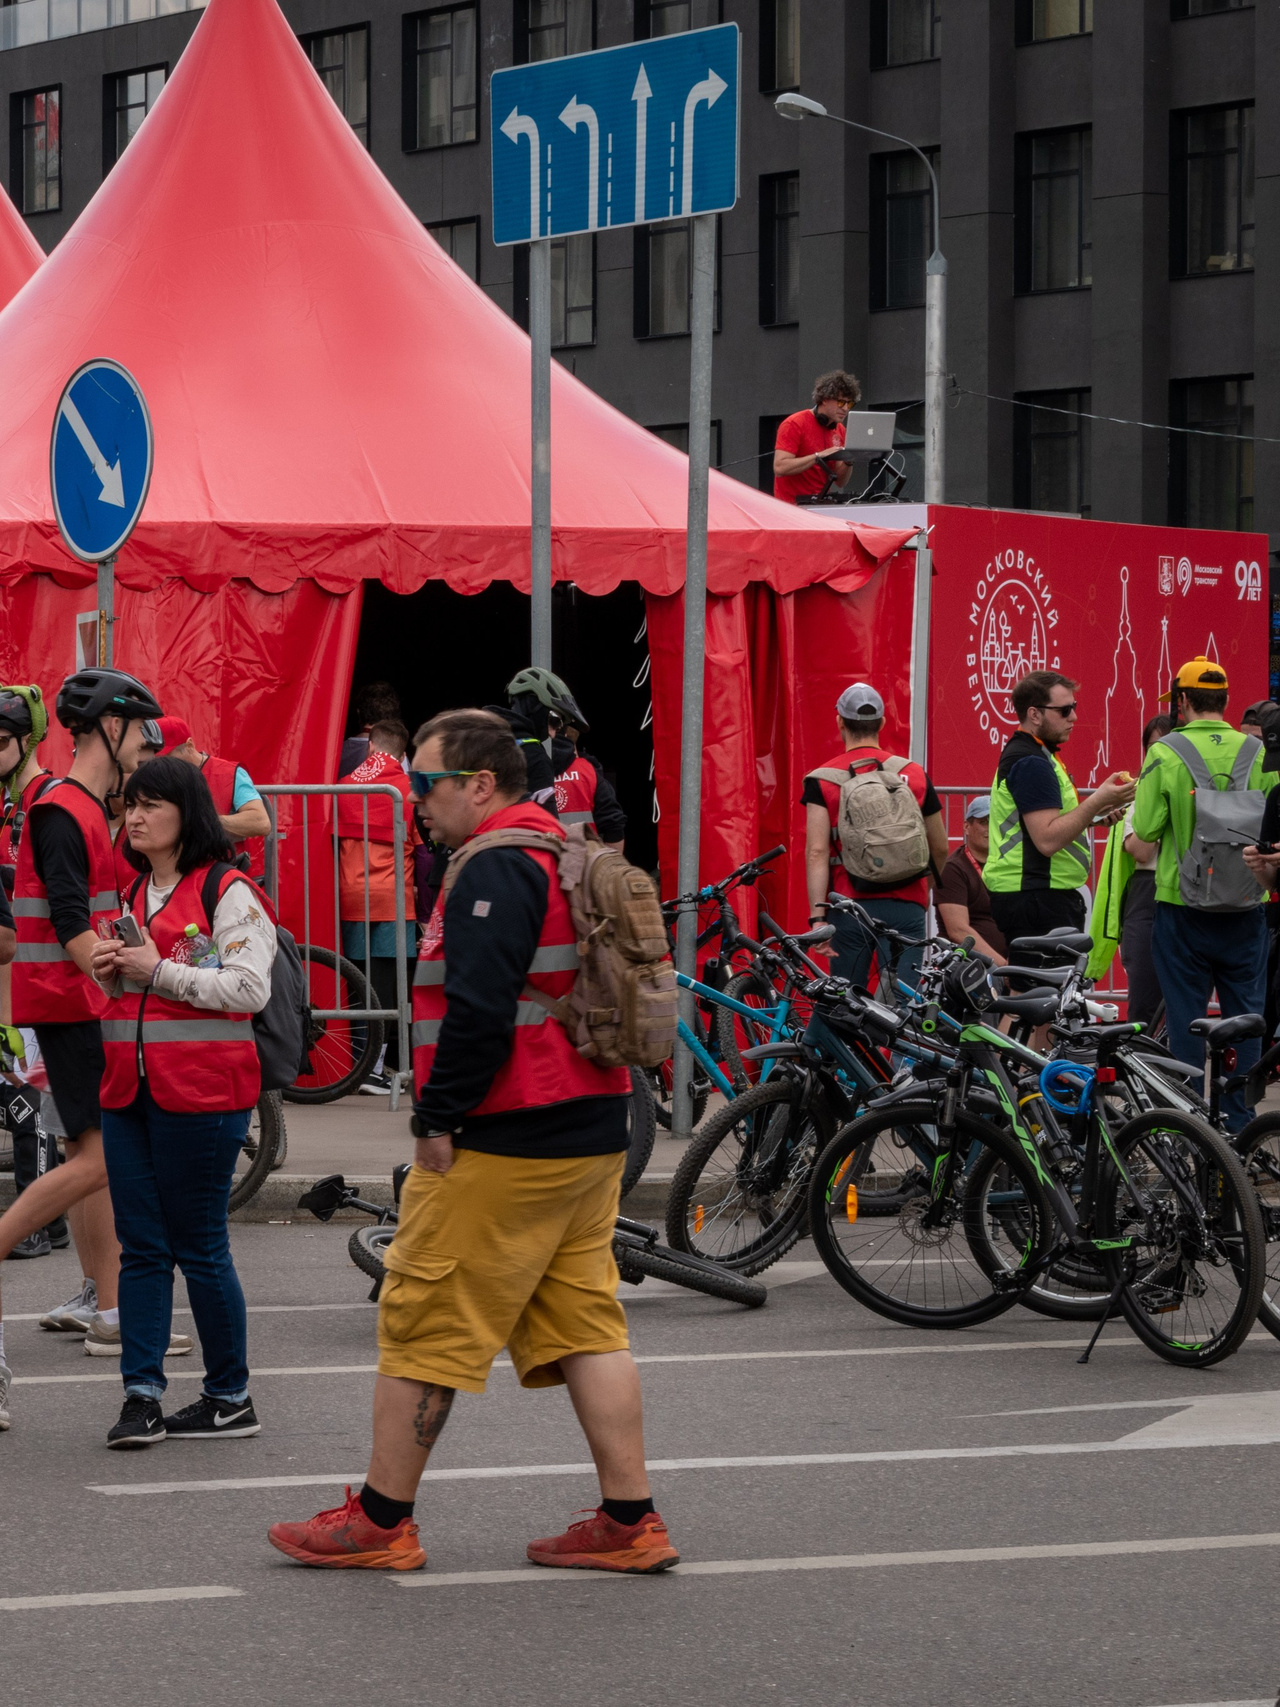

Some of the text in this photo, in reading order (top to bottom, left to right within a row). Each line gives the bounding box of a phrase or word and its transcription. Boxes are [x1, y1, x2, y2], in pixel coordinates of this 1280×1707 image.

[1194, 564, 1223, 575] Московский
[969, 549, 1059, 626] МОСКОВСКИЙ
[1247, 587, 1262, 601] ЛЕТ
